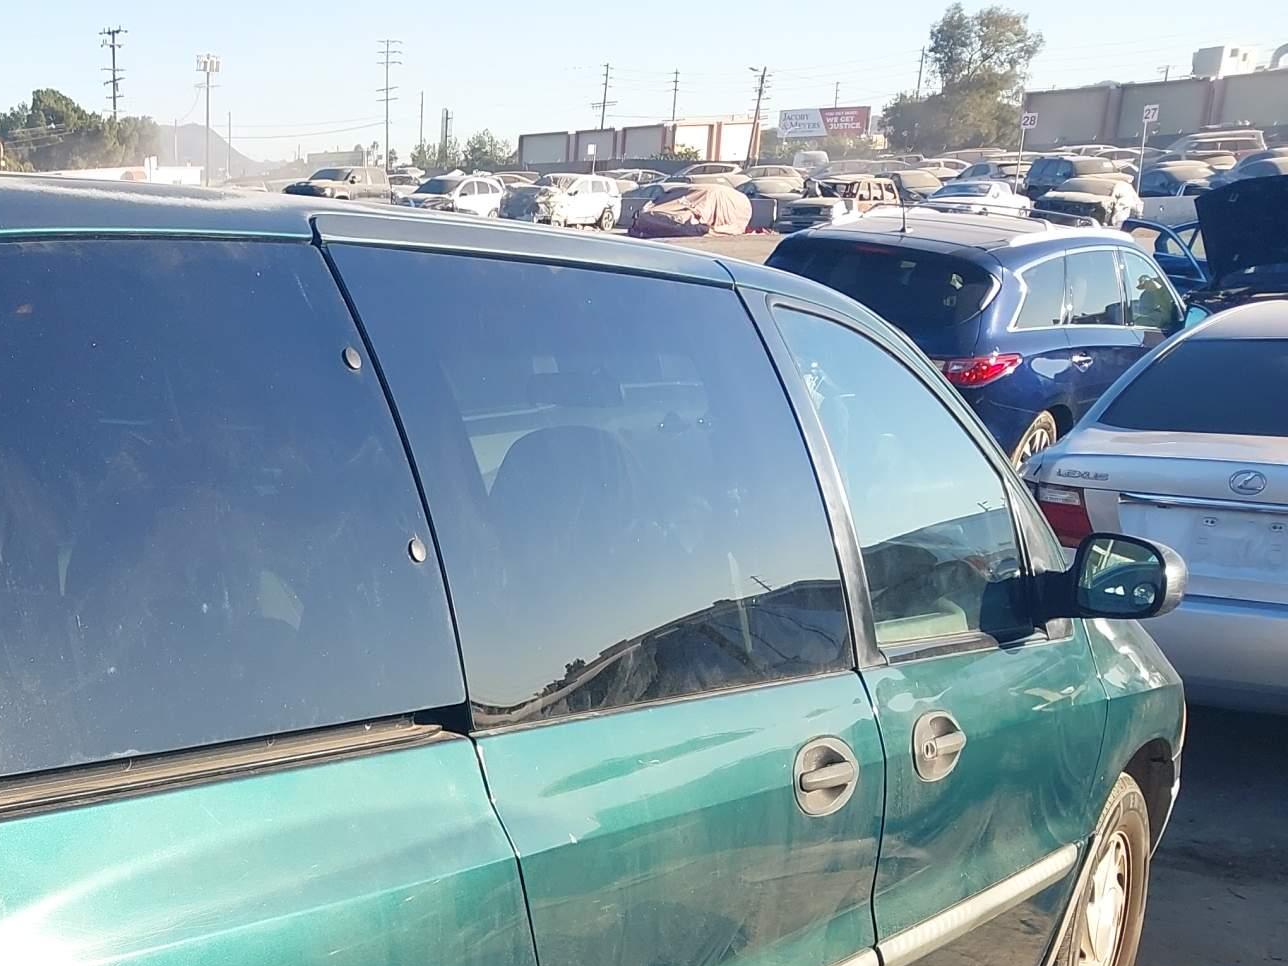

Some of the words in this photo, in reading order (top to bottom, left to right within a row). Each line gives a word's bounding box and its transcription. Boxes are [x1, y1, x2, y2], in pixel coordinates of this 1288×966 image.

[1144, 108, 1158, 120] 27
[1022, 115, 1037, 126] 28
[1056, 468, 1109, 481] LEXUS
